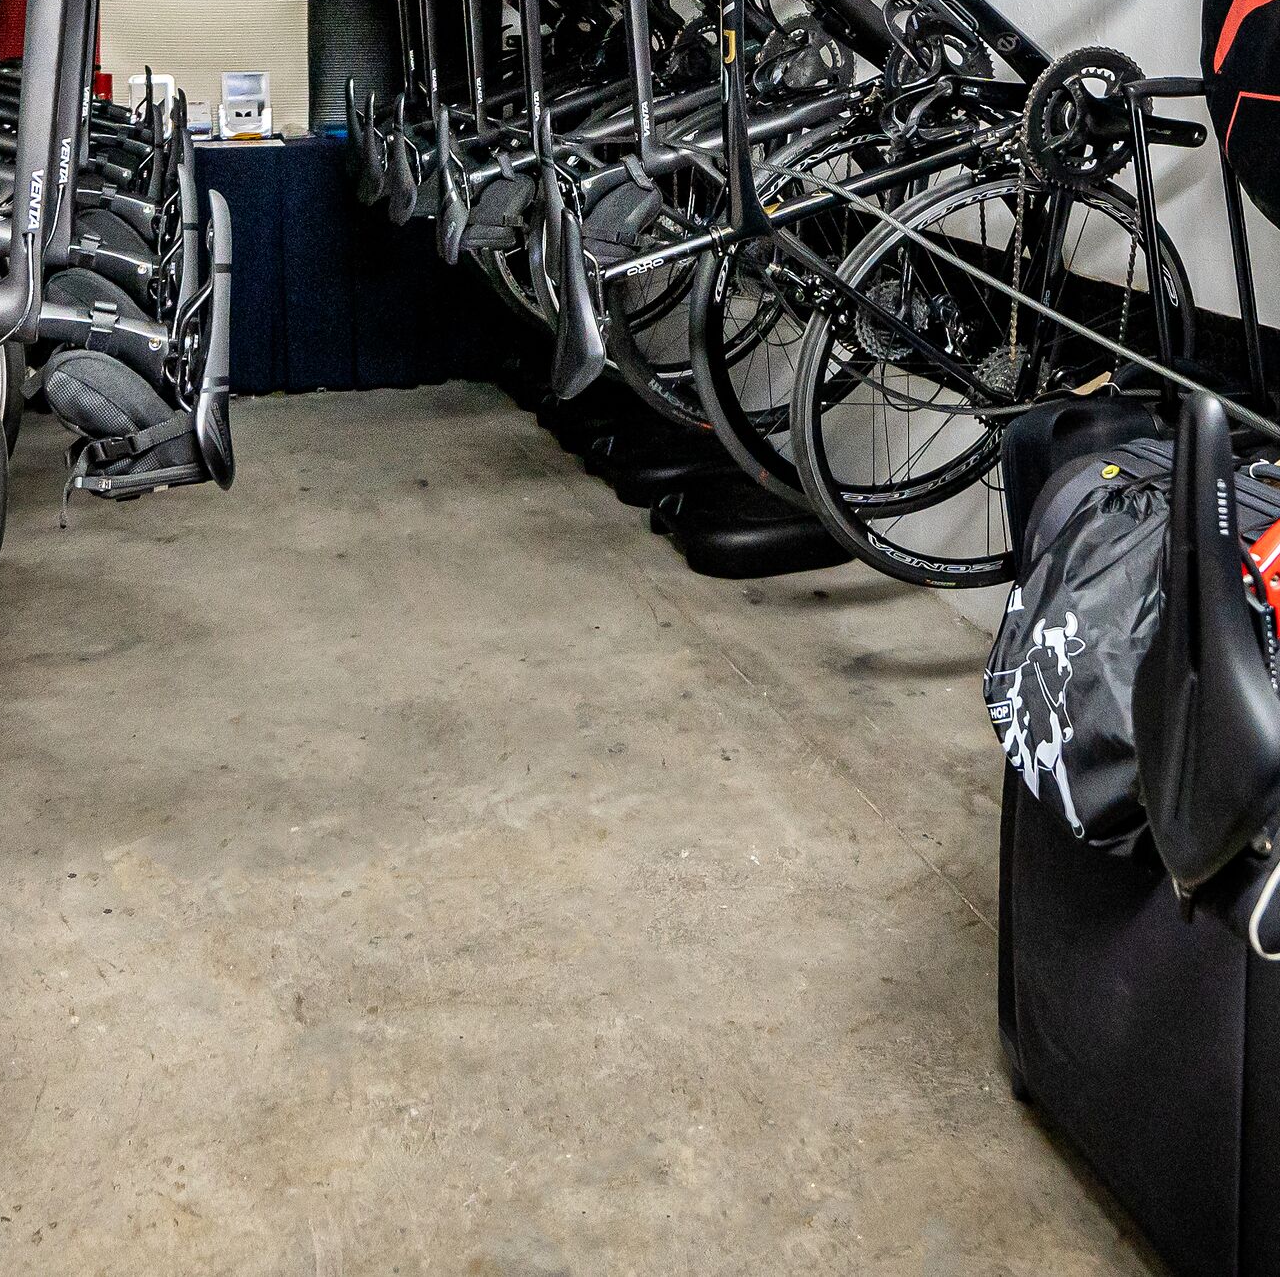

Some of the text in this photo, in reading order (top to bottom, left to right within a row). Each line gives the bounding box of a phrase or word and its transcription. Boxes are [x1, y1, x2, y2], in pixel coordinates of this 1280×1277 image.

[476, 76, 484, 104] VENTA
[532, 90, 541, 121] VENTA
[643, 100, 653, 136] VENTA
[58, 137, 72, 183] VENTA
[28, 169, 45, 230] VENTA
[990, 705, 1010, 720] HOP
